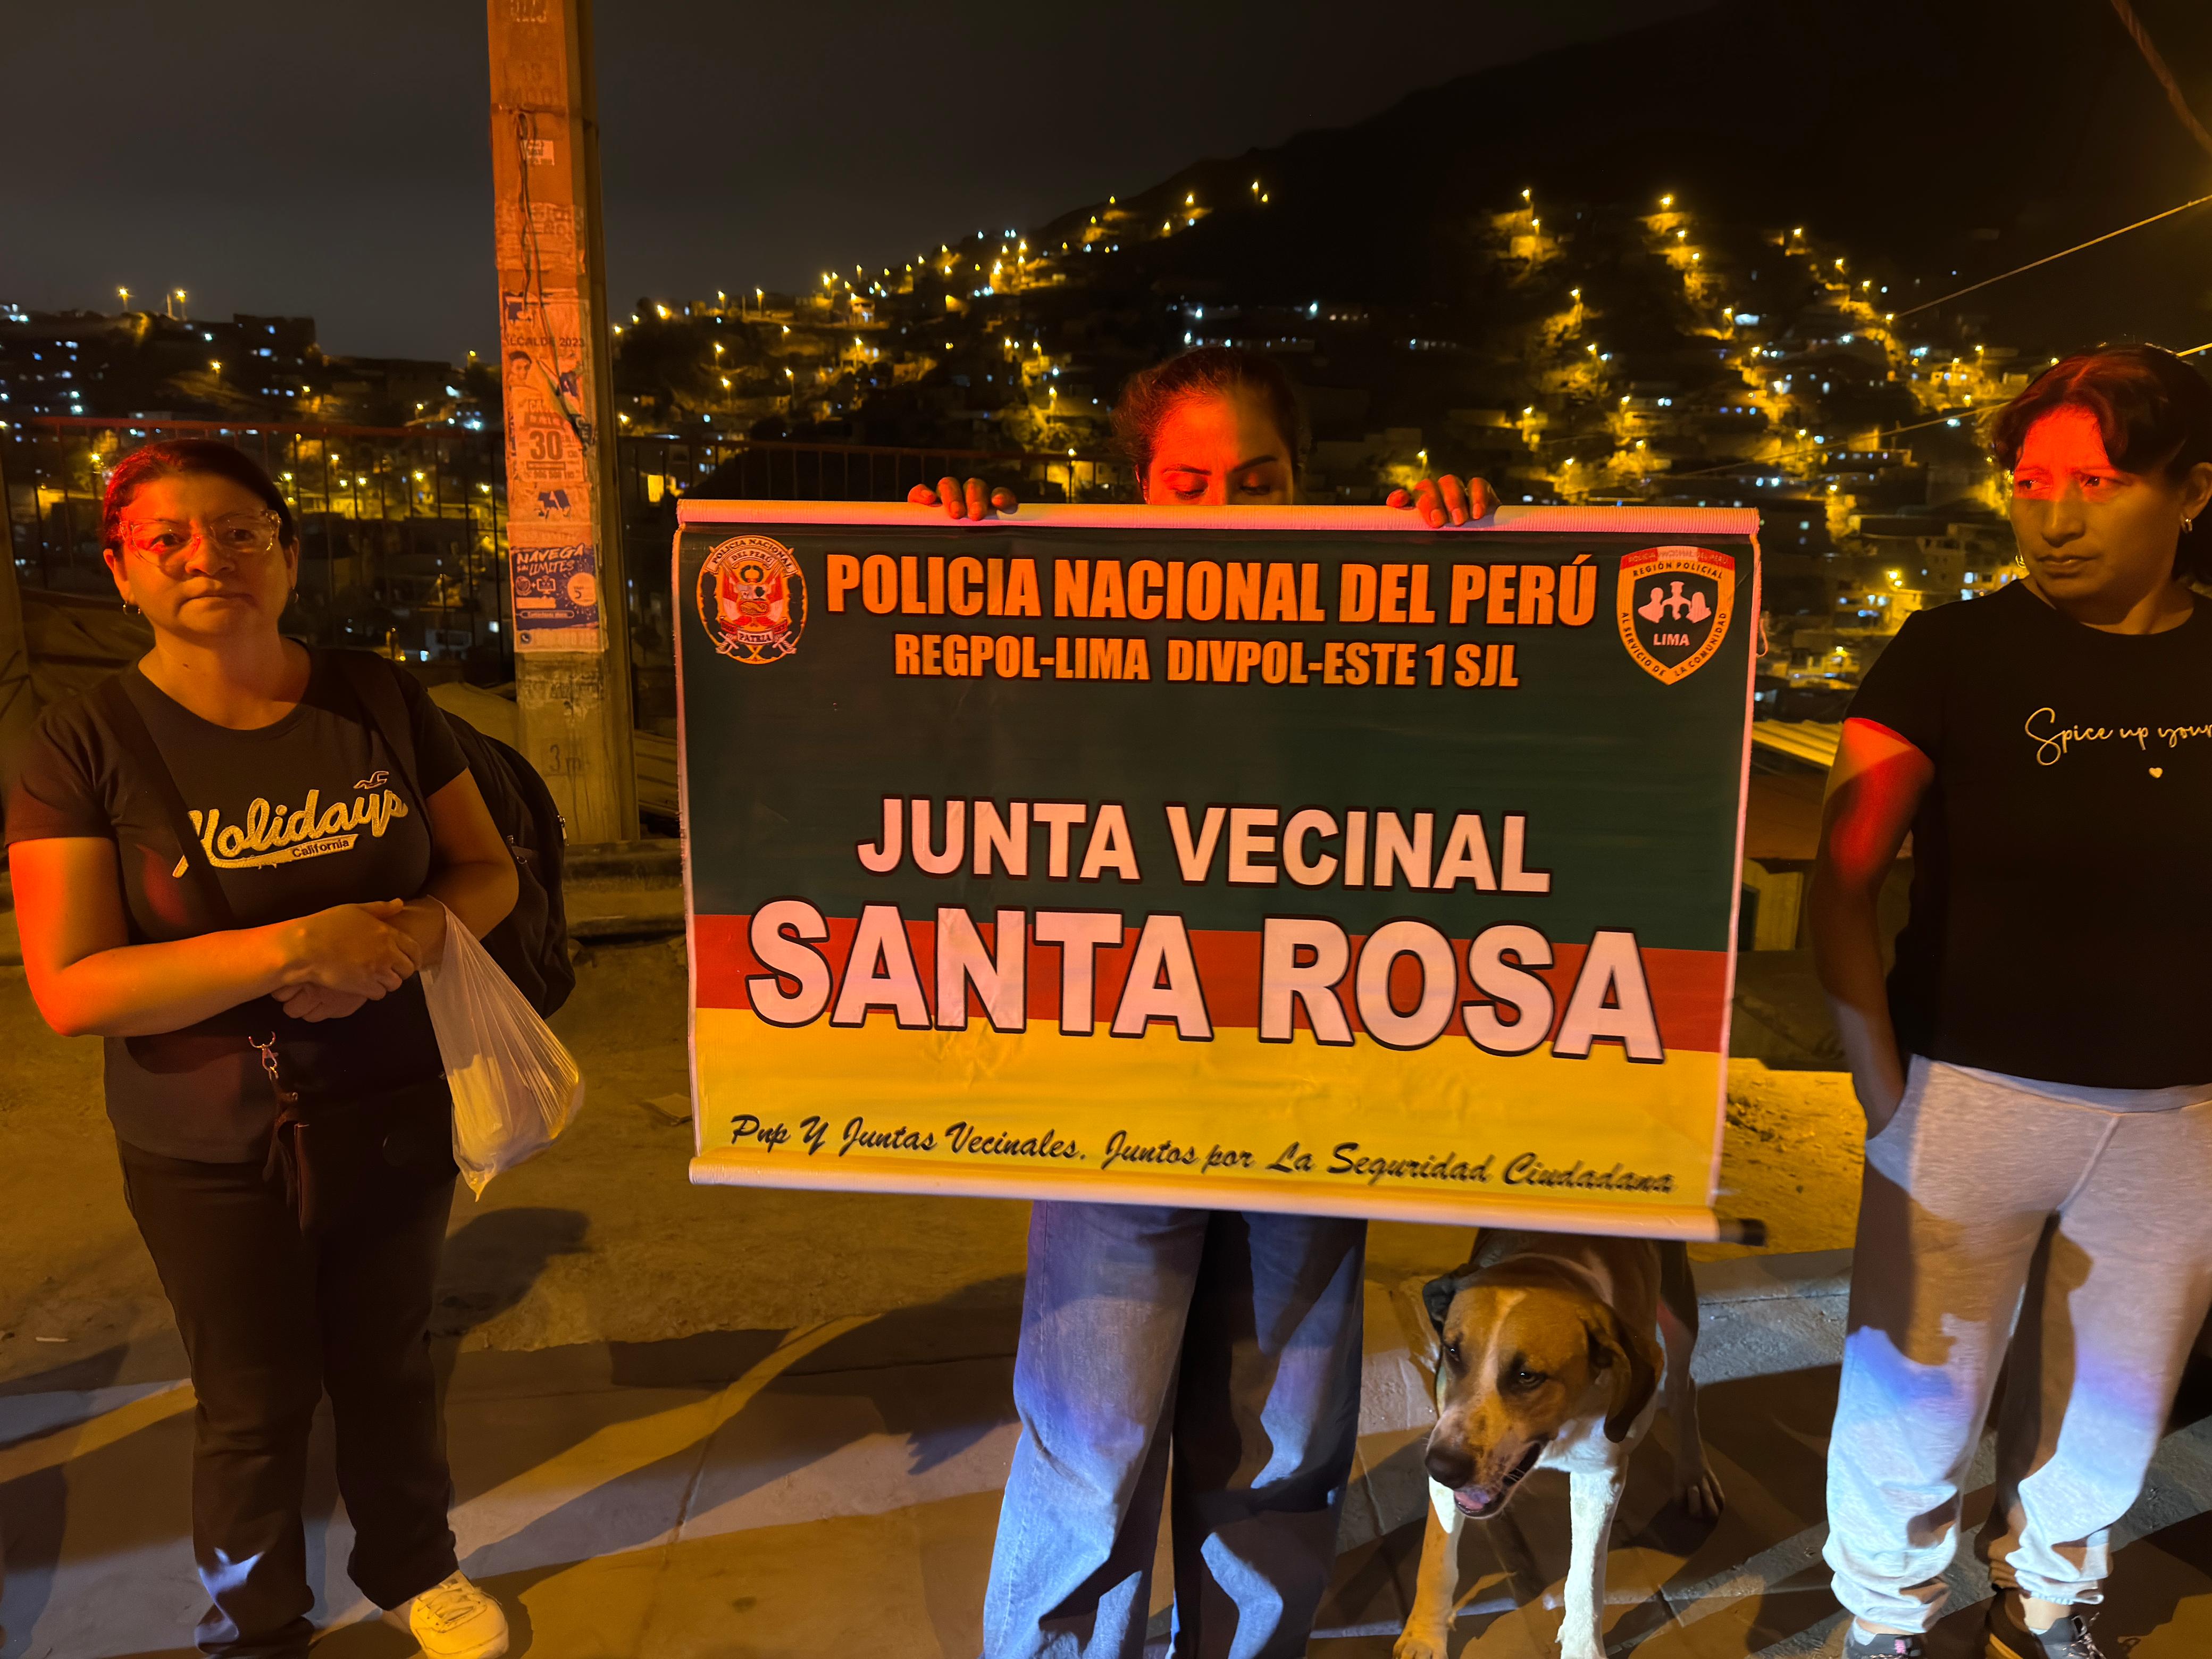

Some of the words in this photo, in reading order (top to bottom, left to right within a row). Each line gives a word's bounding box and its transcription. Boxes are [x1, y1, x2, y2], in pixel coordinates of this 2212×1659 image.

[529, 430, 564, 460] 30
[516, 543, 585, 565] NAVEGA
[529, 559, 575, 576] LIMITES
[731, 551, 748, 561] DEL
[749, 539, 791, 568] NACIONAL
[1633, 562, 1672, 577] REGIÓN
[1677, 562, 1723, 579] POLICIAL
[827, 554, 1042, 617] POLICIA
[1054, 559, 1326, 622] NACIONAL
[1339, 564, 1436, 623] DEL
[1449, 554, 1597, 626] PERÚ
[1622, 612, 1629, 624] AL
[738, 632, 772, 642] PATRIA
[1622, 627, 1651, 667] SERVICIO
[1653, 633, 1690, 647] LIMA
[1688, 613, 1727, 668] COMUNIDAD
[895, 633, 1151, 681] REGPOL-LIMA
[1168, 639, 1417, 686] DIVPOL-ESTE
[1426, 644, 1445, 686] 1
[1455, 644, 1519, 687] SJL
[1652, 665, 1665, 677] DE
[2025, 707, 2114, 766] Spice
[2119, 726, 2149, 751] up
[291, 839, 350, 858] California
[857, 797, 1142, 883] JUNTA
[1165, 805, 1552, 895] VECINAL
[745, 898, 1215, 1043] SANTA
[1259, 916, 1666, 1064] ROSA
[731, 1114, 791, 1153] Pnp
[799, 1116, 830, 1156] Y
[839, 1117, 938, 1157] Juntas
[944, 1121, 1086, 1160] Vecinales.
[1101, 1129, 1199, 1170] Juntos
[1200, 1143, 1256, 1175] por
[1265, 1141, 1315, 1173] La
[1326, 1141, 1497, 1186] Seguridad
[1502, 1151, 1676, 1195] Ciudadana
